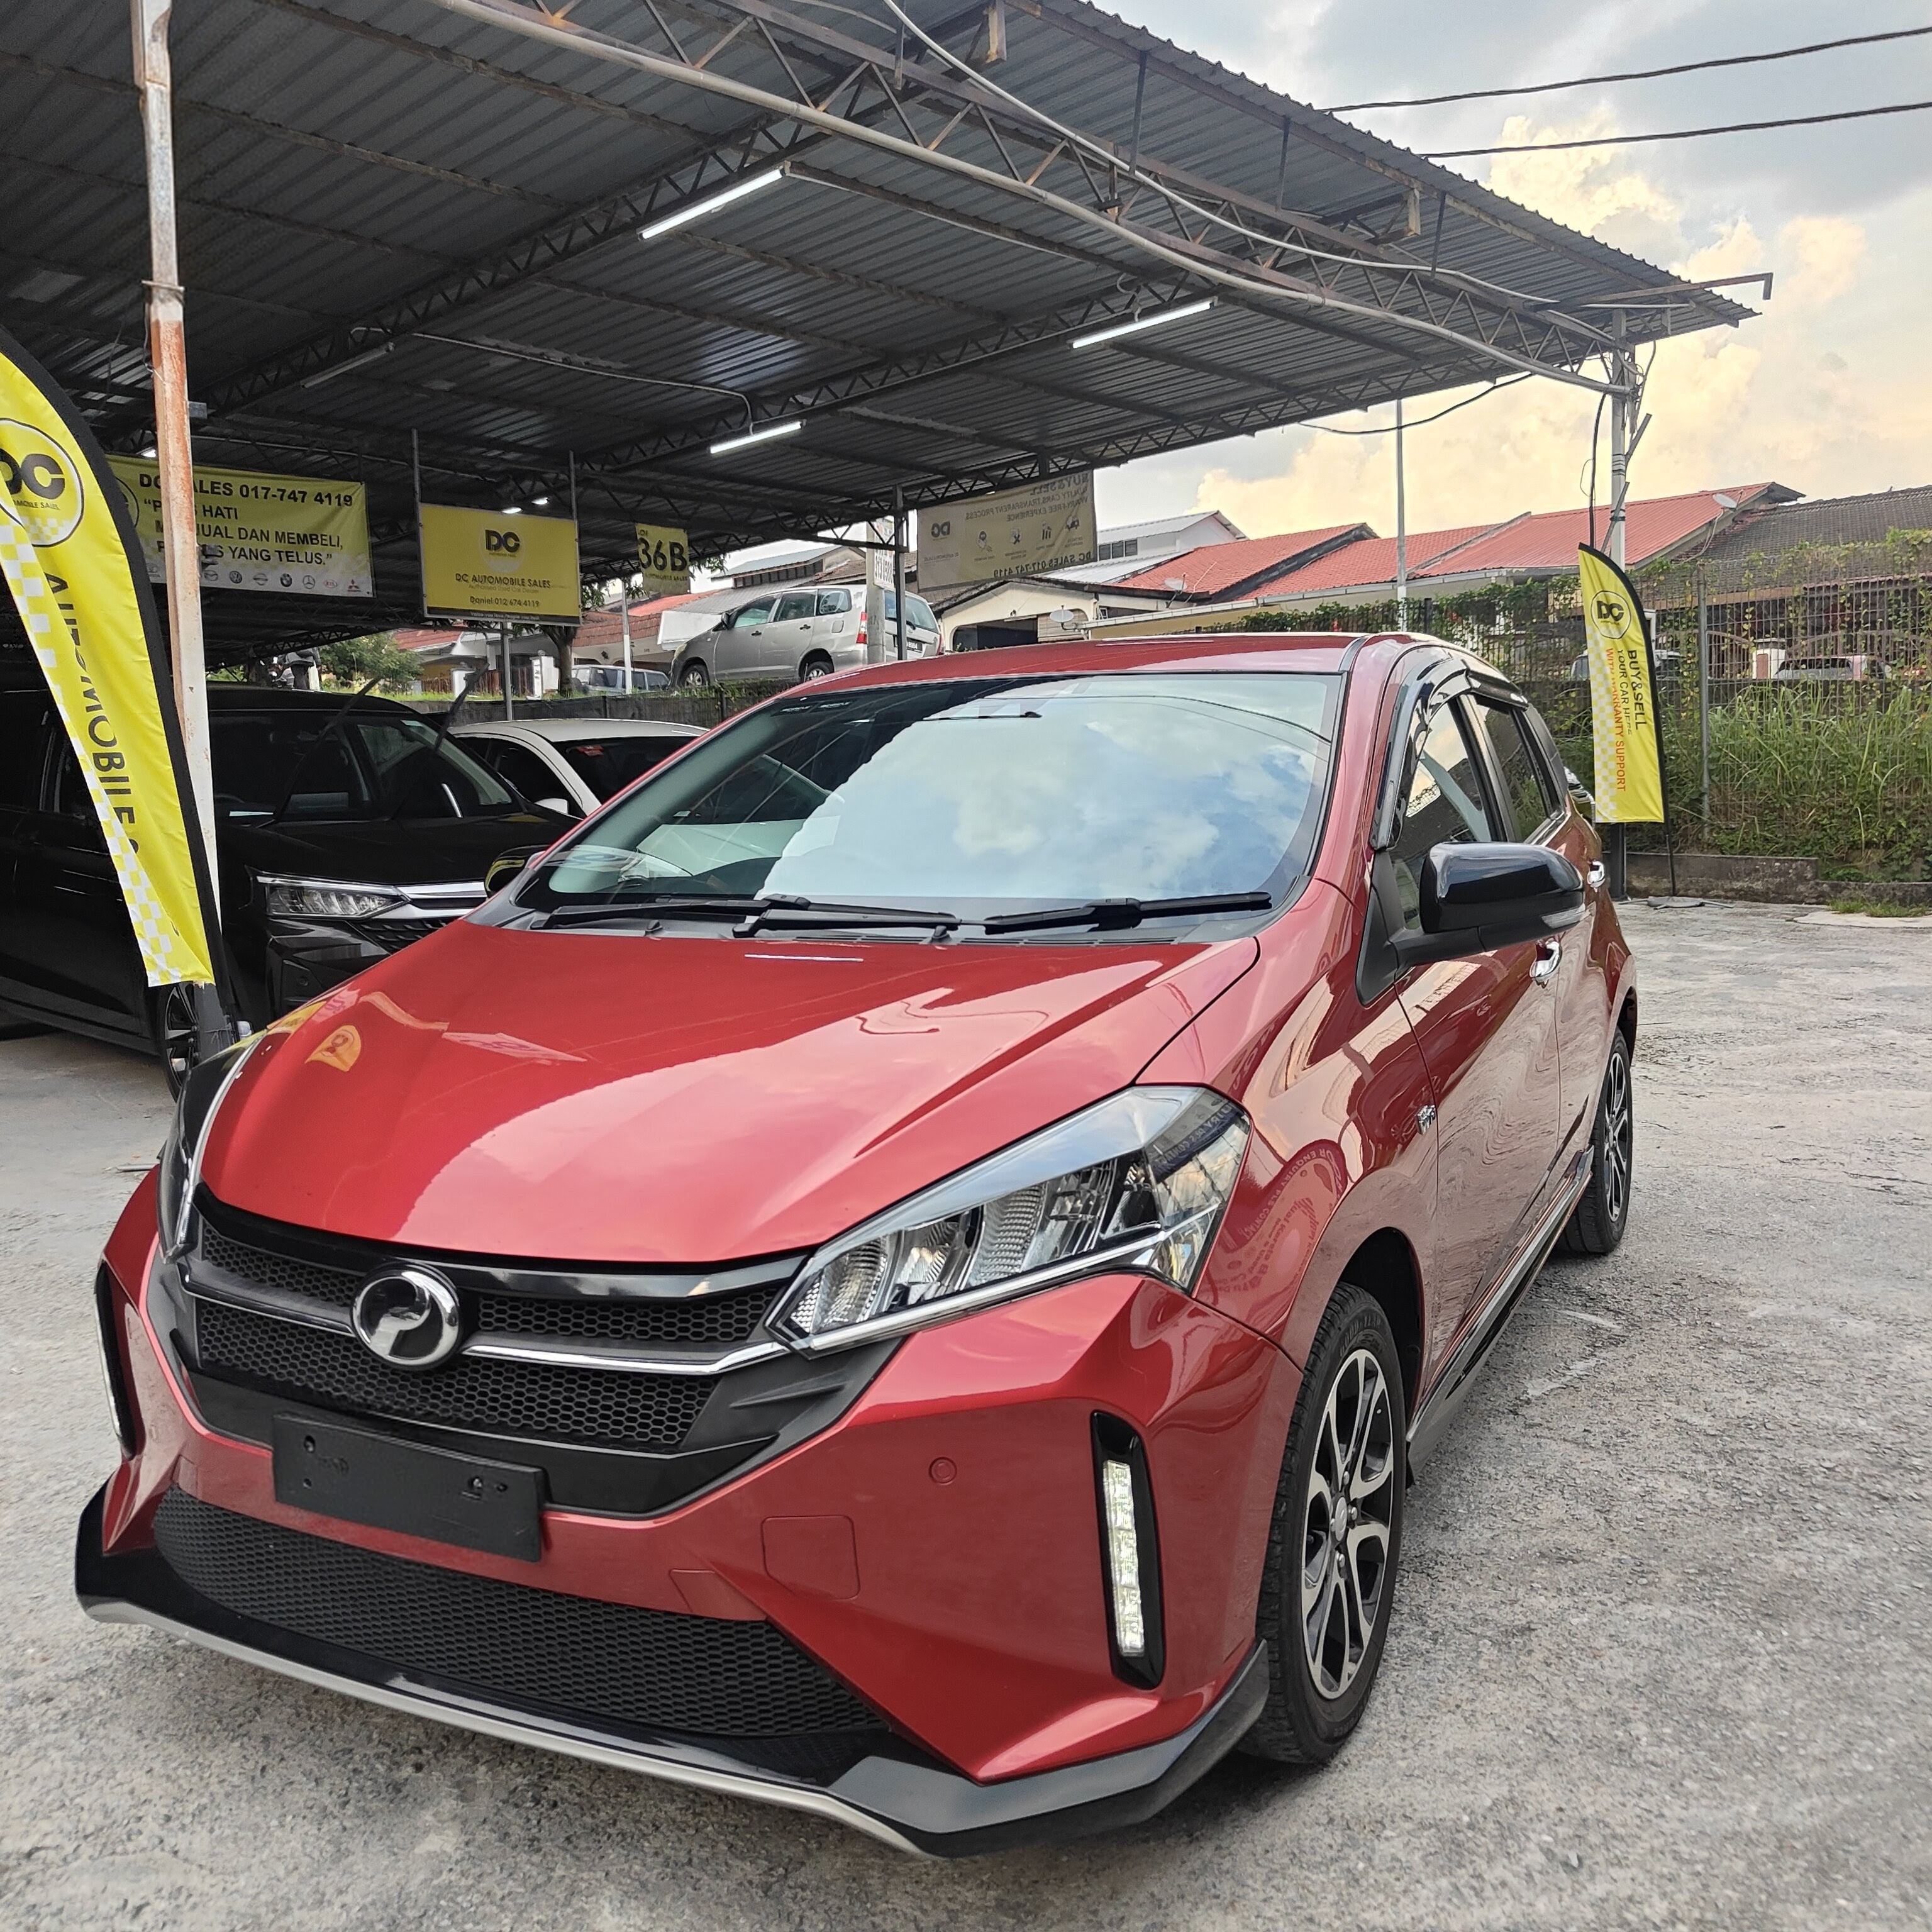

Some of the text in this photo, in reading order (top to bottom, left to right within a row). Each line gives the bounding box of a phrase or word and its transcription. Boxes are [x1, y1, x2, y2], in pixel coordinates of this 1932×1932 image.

[193, 479, 233, 496] LES
[239, 484, 308, 502] 017-747
[314, 492, 353, 507] 4119
[202, 504, 238, 520] HATI
[155, 520, 343, 550] MJUAL DAN MEMBELI,
[485, 529, 521, 553] DC
[229, 545, 271, 562] YANG
[638, 536, 687, 572] 36B
[455, 573, 469, 582] DC
[471, 575, 525, 587] AUTOMOBILE
[527, 579, 552, 589] SALES
[470, 596, 540, 608] Daniel 012 674 4119
[1596, 600, 1624, 622] DC
[1617, 649, 1628, 679] YOUR
[1619, 682, 1629, 704] CAR
[1627, 649, 1648, 730] BUY&SELL
[1615, 740, 1626, 792] SUPPORT
